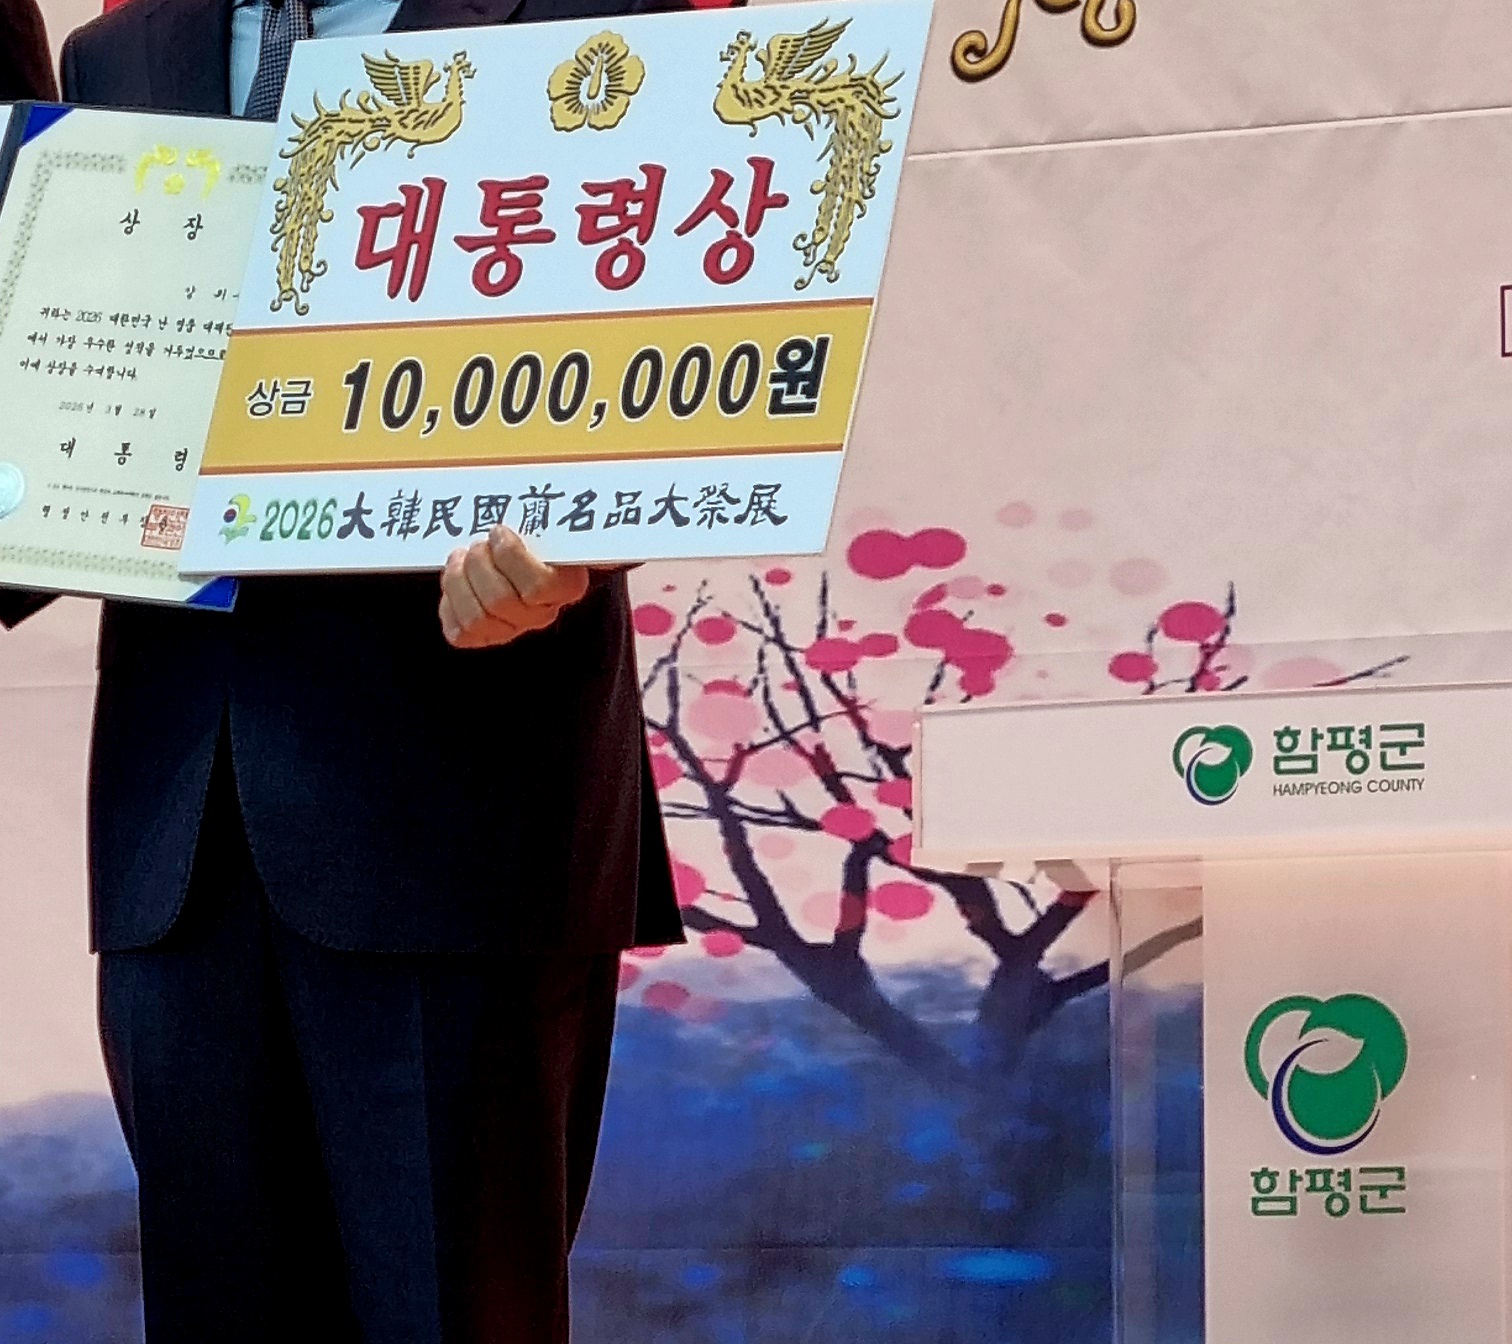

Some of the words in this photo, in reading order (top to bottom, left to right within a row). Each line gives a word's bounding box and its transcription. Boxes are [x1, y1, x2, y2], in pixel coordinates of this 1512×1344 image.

[356, 154, 792, 302] 대통령상
[246, 379, 313, 418] 상금
[343, 335, 833, 436] 10,000,000원
[1272, 722, 1426, 775] 함평군
[1273, 780, 1363, 797] HAMPYEONG
[1366, 777, 1426, 794] COUNTY
[1250, 1166, 1406, 1217] 함평군
